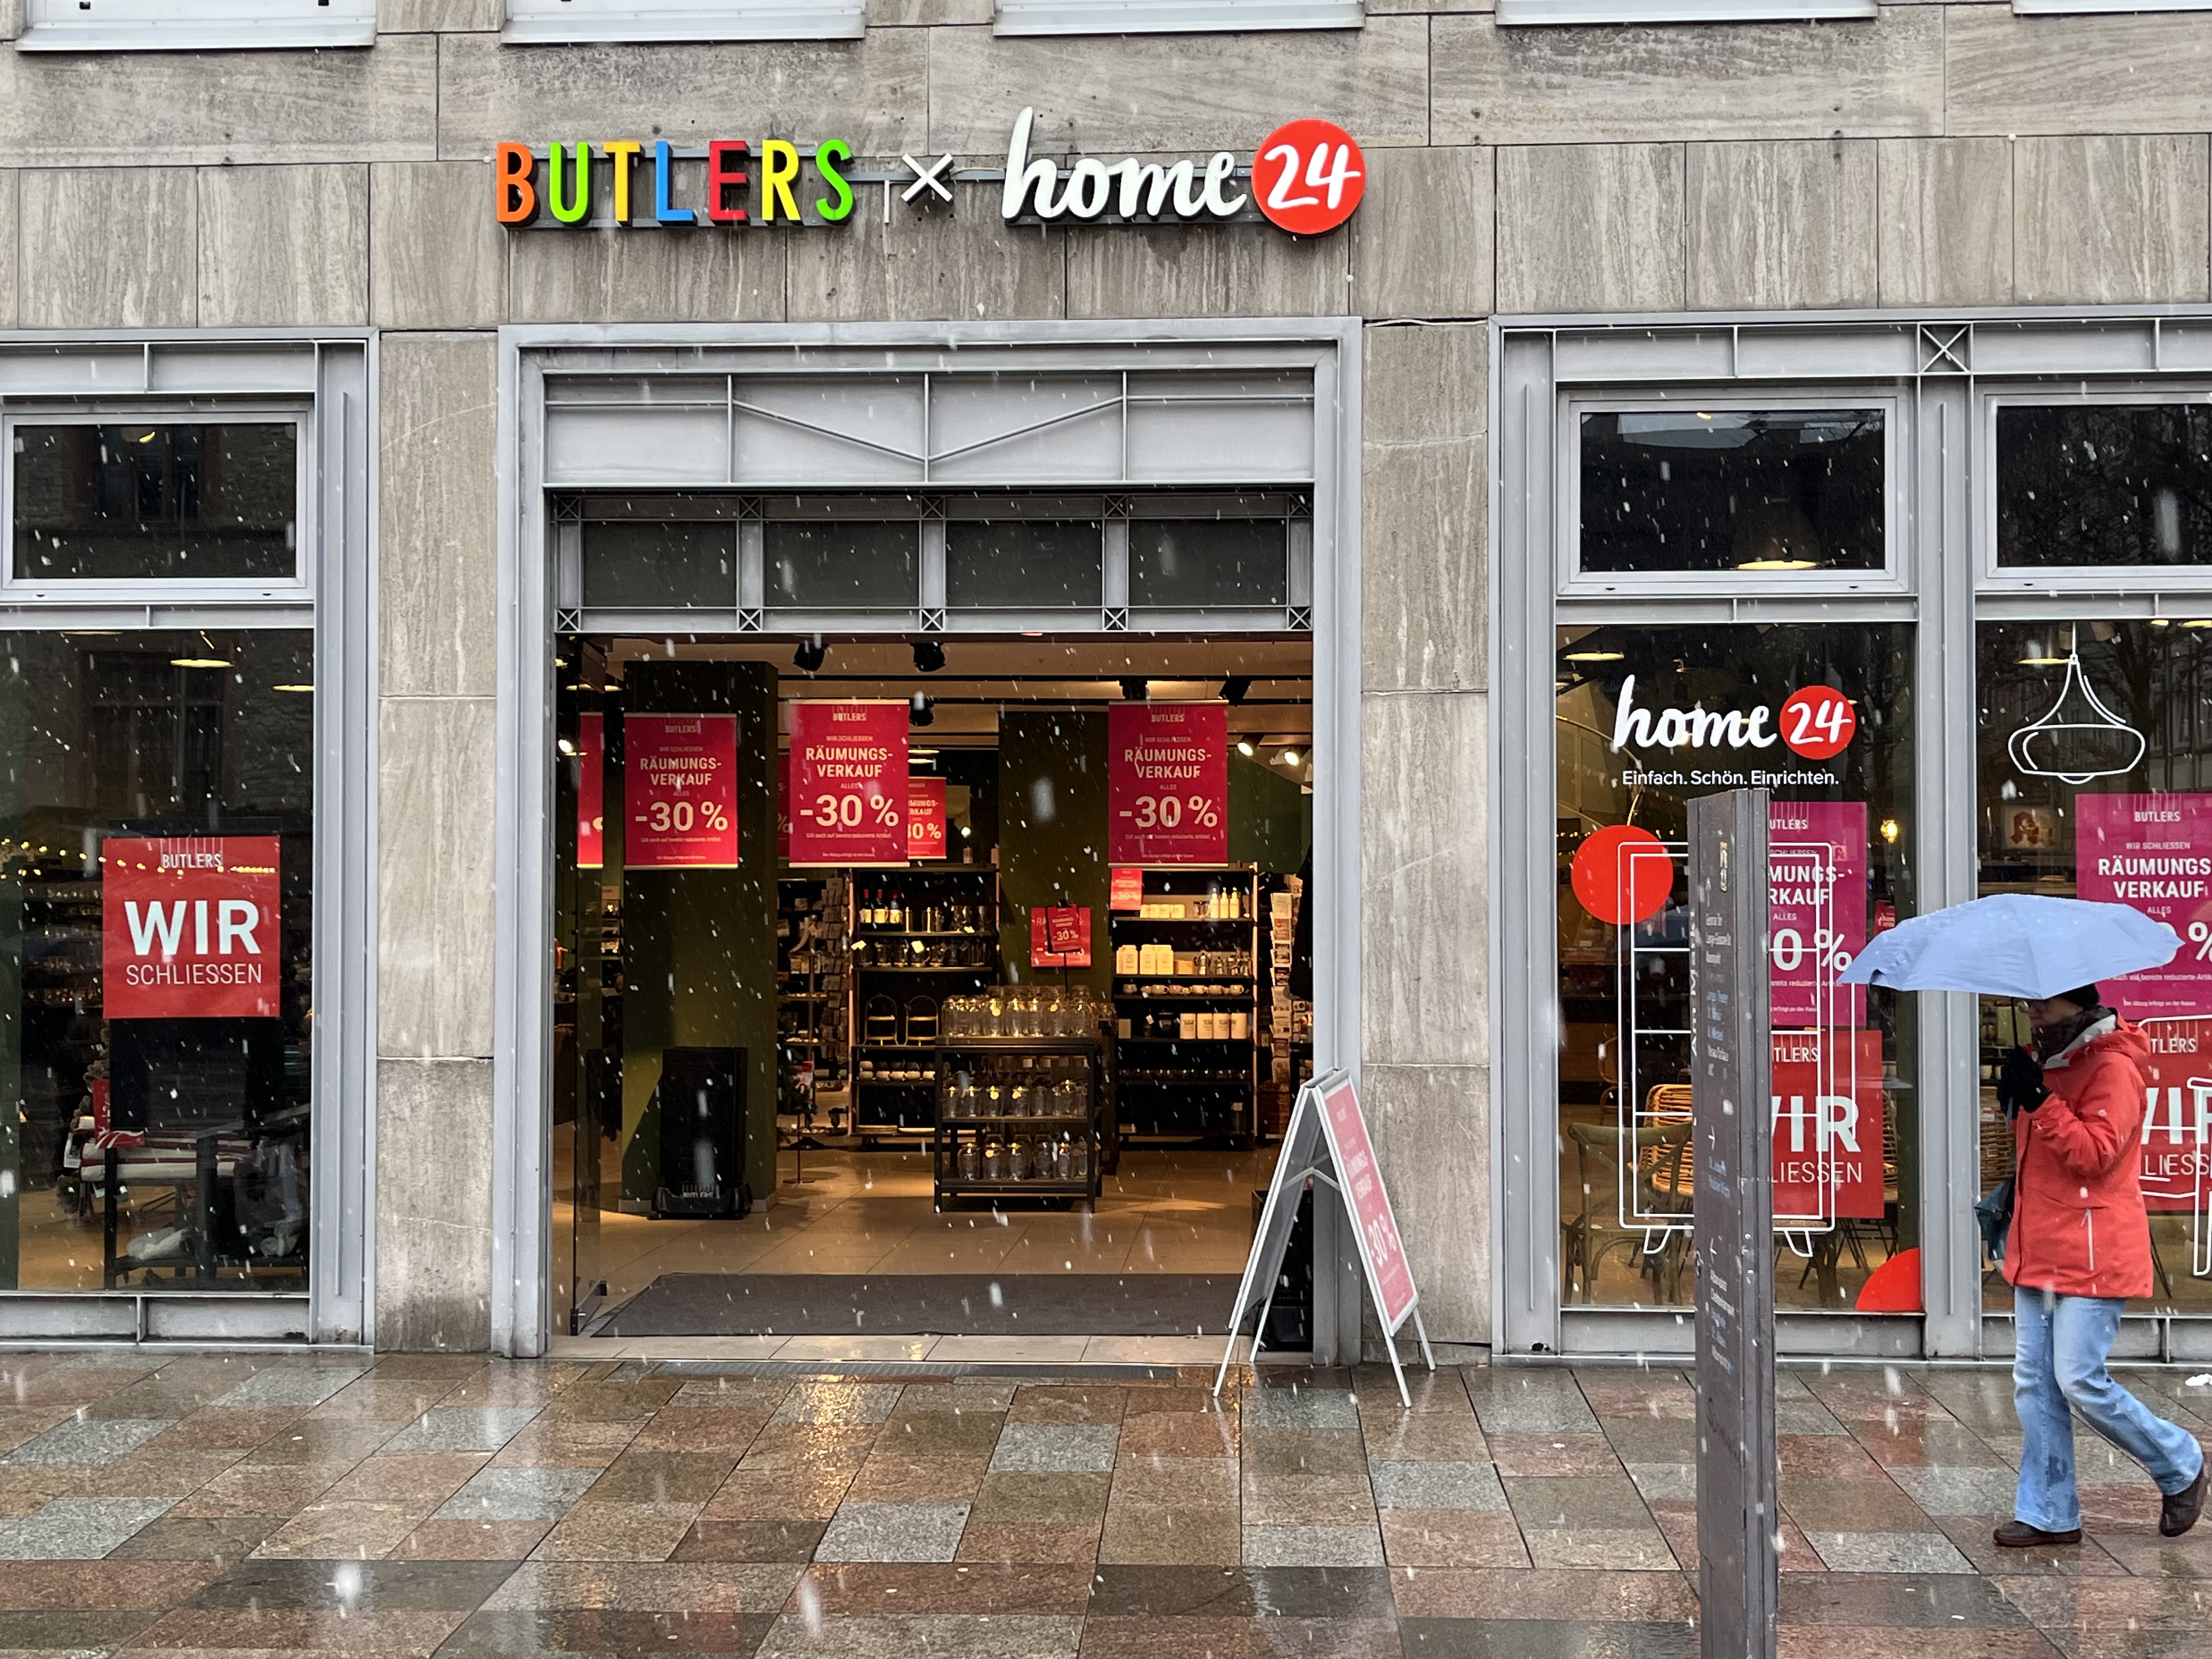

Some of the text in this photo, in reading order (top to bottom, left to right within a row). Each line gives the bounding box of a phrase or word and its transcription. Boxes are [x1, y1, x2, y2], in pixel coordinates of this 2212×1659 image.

[495, 139, 855, 224] BUTLERS
[1002, 106, 1248, 221] home
[1263, 144, 1362, 210] 24
[1151, 714, 1185, 723] BUTLERS
[1613, 675, 1852, 748] home 24
[805, 745, 893, 760] RÄUMUNGS-
[1125, 746, 1212, 762] RÄUMUNGS-
[640, 755, 722, 770] RÄUMUNGS-
[816, 764, 883, 777] VERKAUF
[651, 773, 712, 786] VERKAUF
[1137, 765, 1201, 778] VERKAUF
[1622, 770, 1839, 785] Einfach. Schön. Einrichten.
[635, 801, 729, 832] -30 %
[799, 794, 899, 827] -30 %
[1119, 795, 1218, 827] -30 %
[2134, 811, 2181, 822] BUTLERS
[1770, 819, 1808, 830] UTLERS
[162, 853, 222, 868] BUTLERS
[1770, 866, 1845, 882] MUNGS-
[1770, 888, 1830, 905] RKAUF
[2113, 881, 2205, 898] VERKAUF
[125, 900, 261, 956] WIR
[126, 963, 262, 985] SCHLIESSEN
[2151, 1037, 2197, 1053] TLERS
[1774, 1047, 1818, 1063] TLERS
